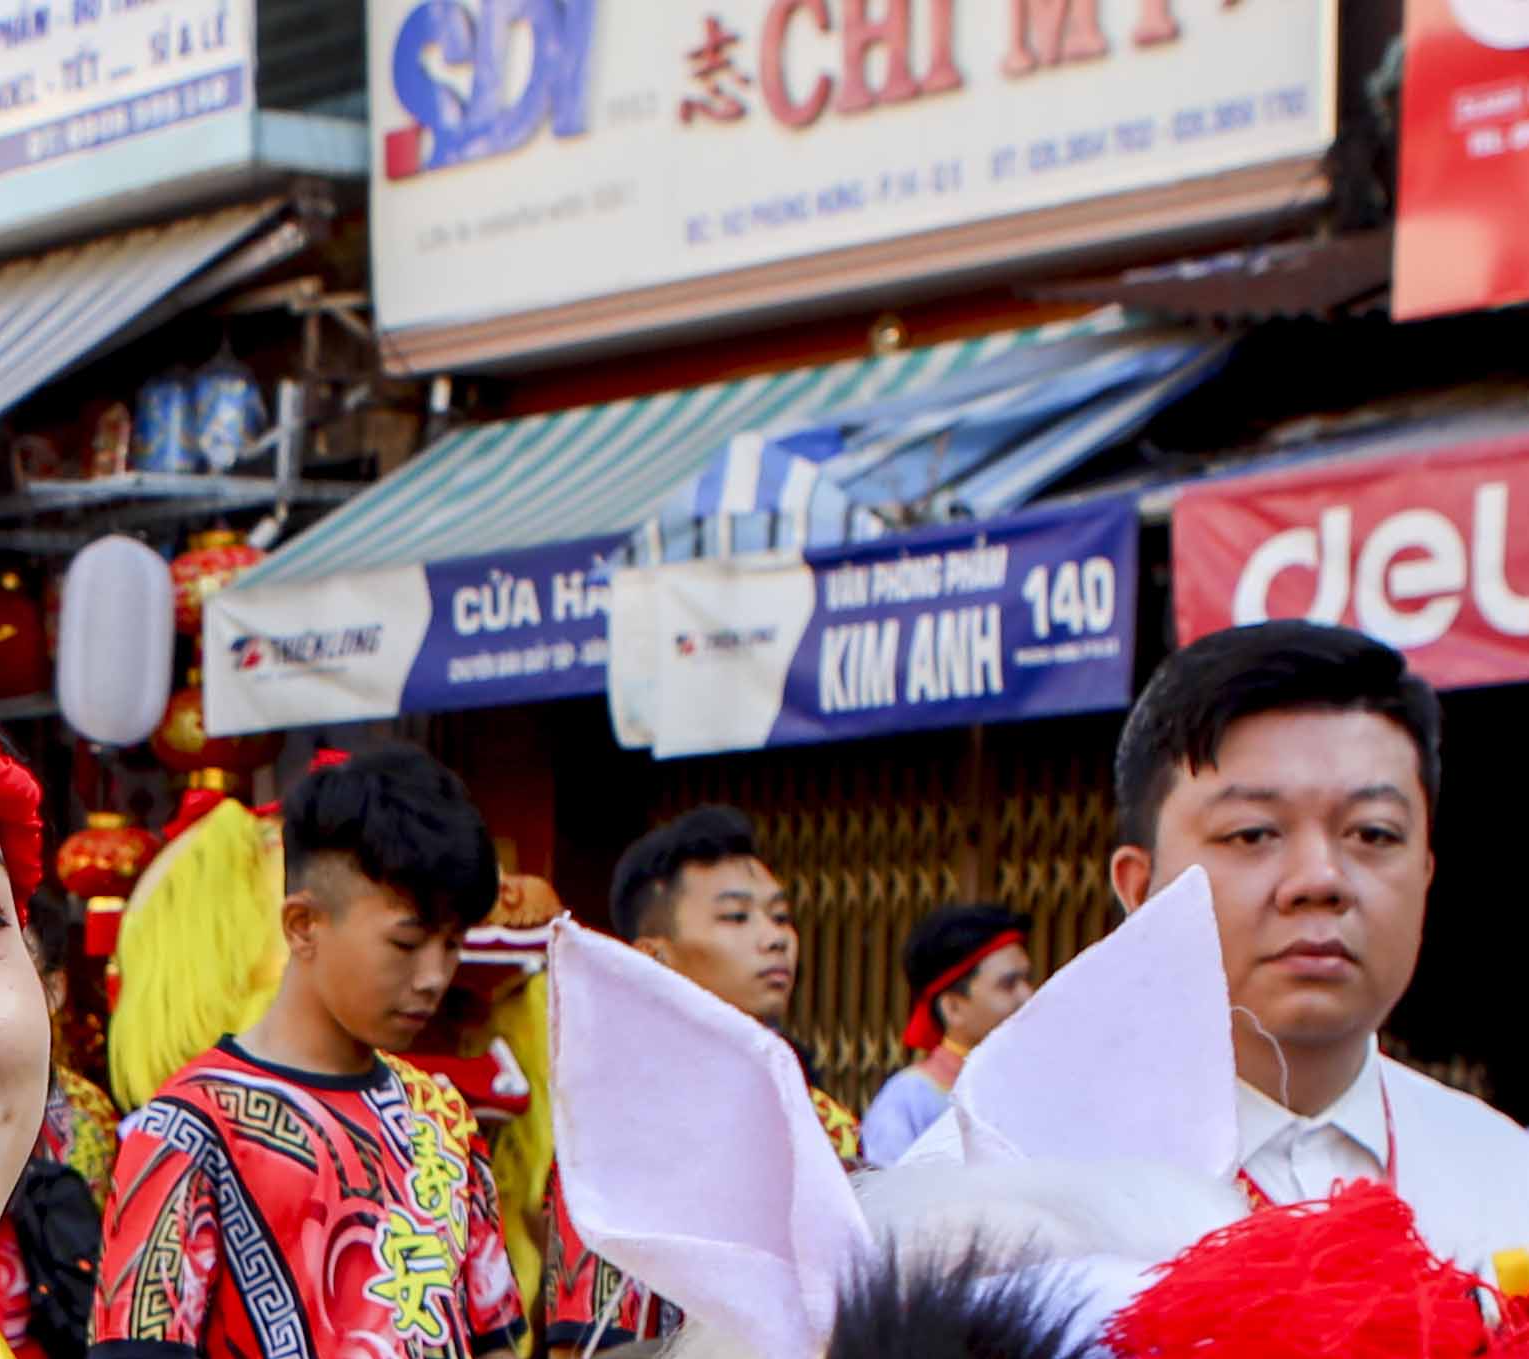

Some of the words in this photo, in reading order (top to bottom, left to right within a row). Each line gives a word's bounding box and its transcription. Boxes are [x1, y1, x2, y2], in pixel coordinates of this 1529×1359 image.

[453, 565, 543, 636] CỬA
[1021, 556, 1117, 640] 140
[819, 617, 901, 715] KIM
[904, 602, 1004, 705] ANH
